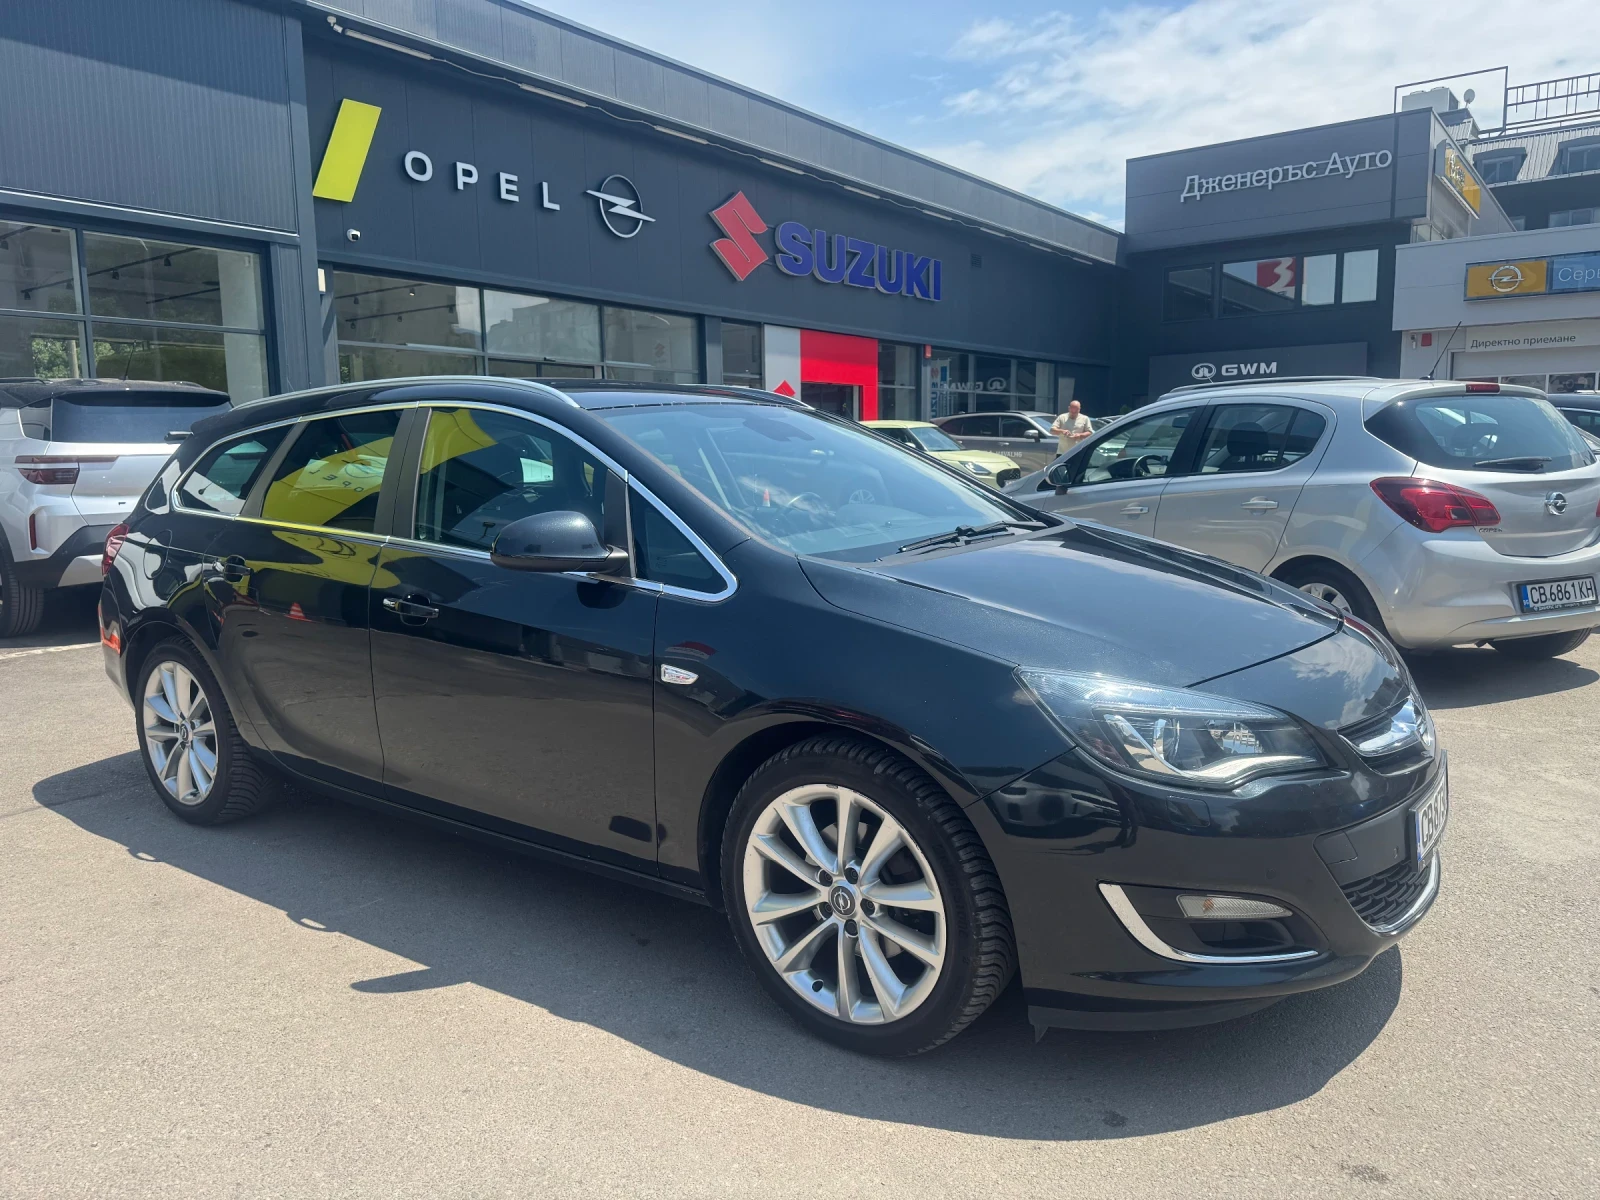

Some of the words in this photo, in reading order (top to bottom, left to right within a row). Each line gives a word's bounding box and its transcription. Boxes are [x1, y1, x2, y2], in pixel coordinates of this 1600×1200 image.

[404, 150, 561, 211] OPEL
[1180, 161, 1317, 203] Дженеръс
[1324, 149, 1393, 179] Ауто
[775, 221, 942, 302] SUZUKI
[1221, 362, 1277, 376] GWM
[1470, 338, 1520, 349] Директно
[1523, 335, 1576, 346] приемане
